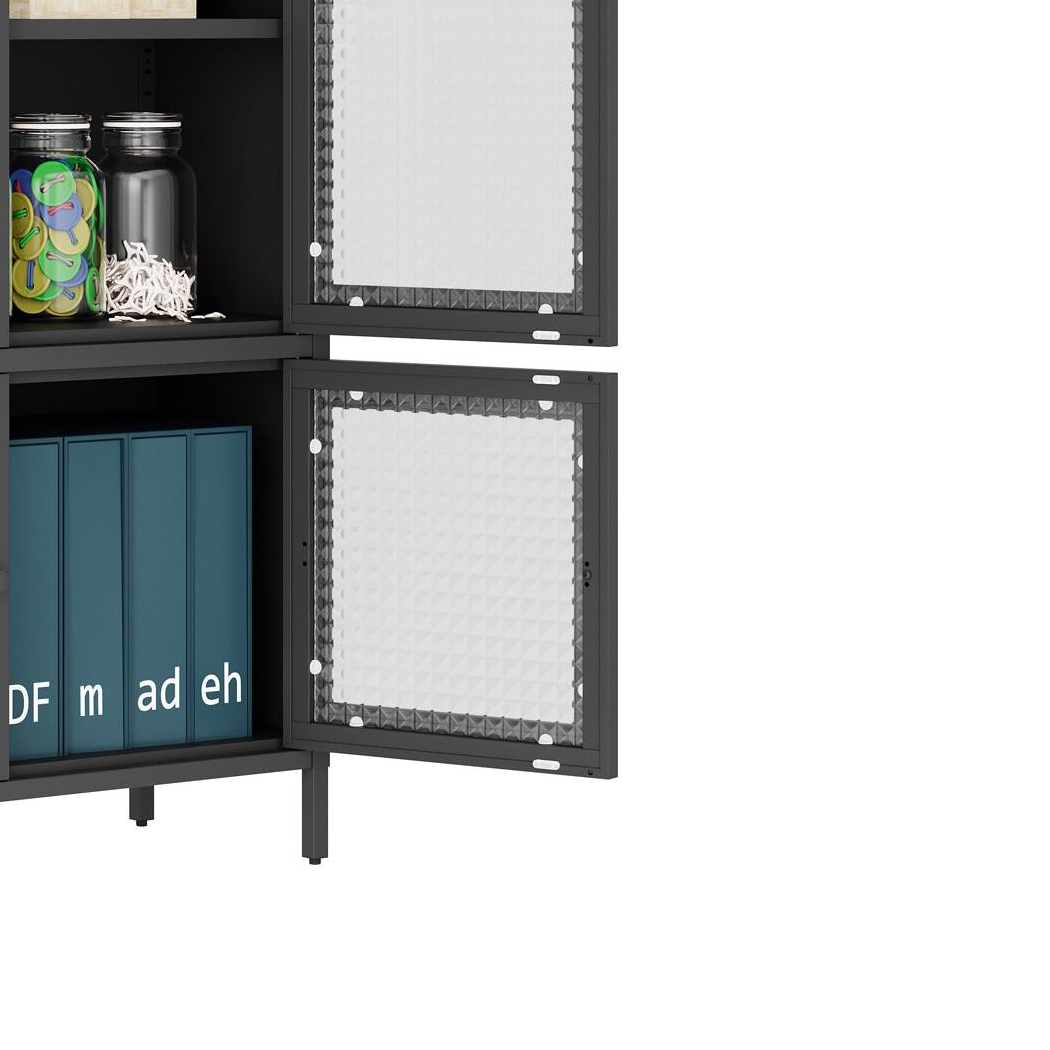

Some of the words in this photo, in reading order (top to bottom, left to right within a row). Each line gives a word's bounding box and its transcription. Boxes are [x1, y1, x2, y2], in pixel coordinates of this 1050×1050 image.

[8, 681, 50, 725] DF
[80, 683, 103, 717] m
[137, 666, 181, 712] ad
[201, 661, 242, 706] eh
